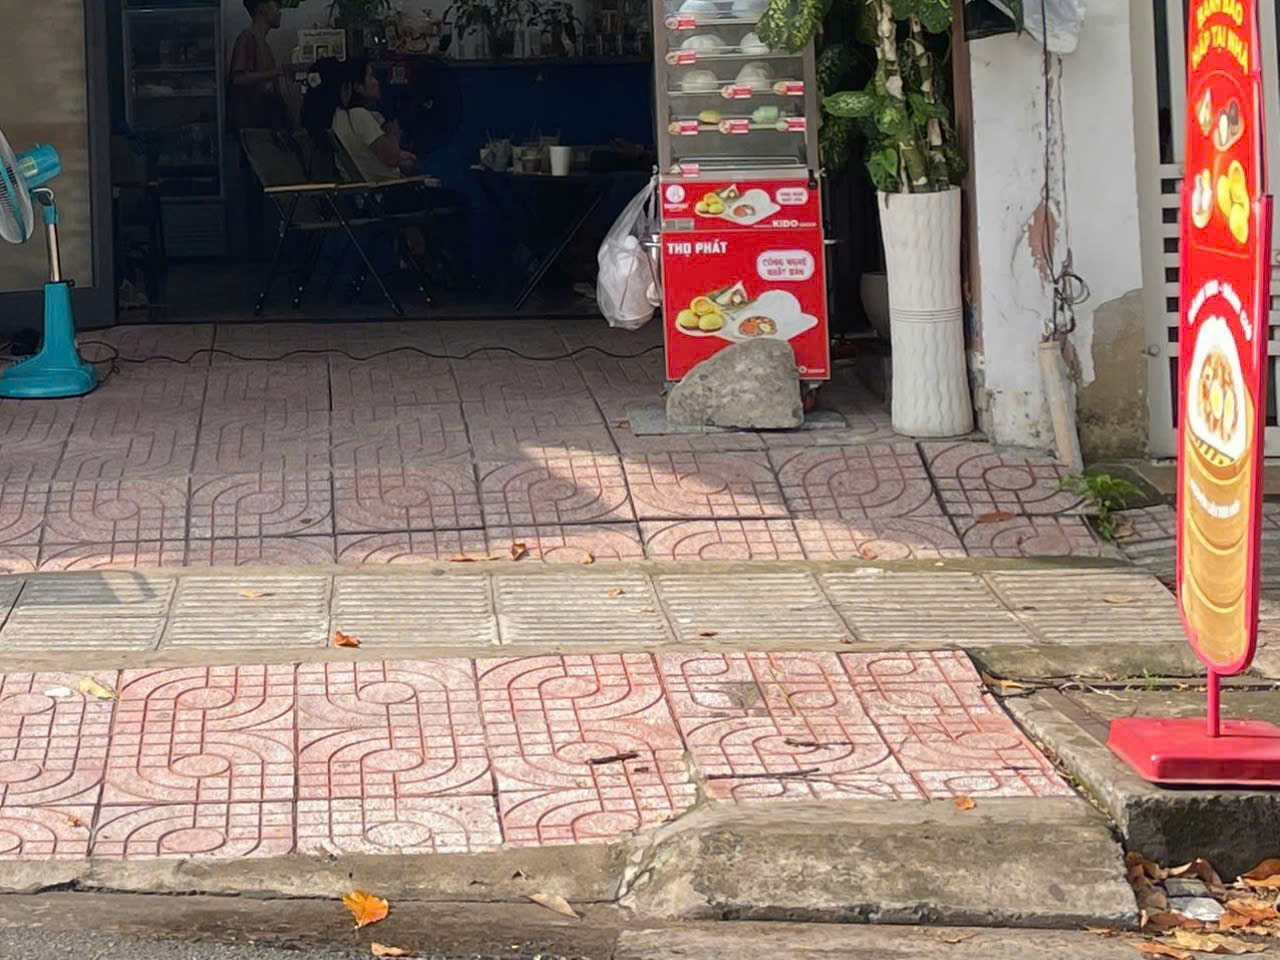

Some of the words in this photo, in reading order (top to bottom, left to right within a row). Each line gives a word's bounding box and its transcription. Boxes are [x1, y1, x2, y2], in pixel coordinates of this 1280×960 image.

[772, 219, 799, 228] KIDO
[667, 241, 692, 257] THỌ
[695, 238, 728, 254] PHÁT
